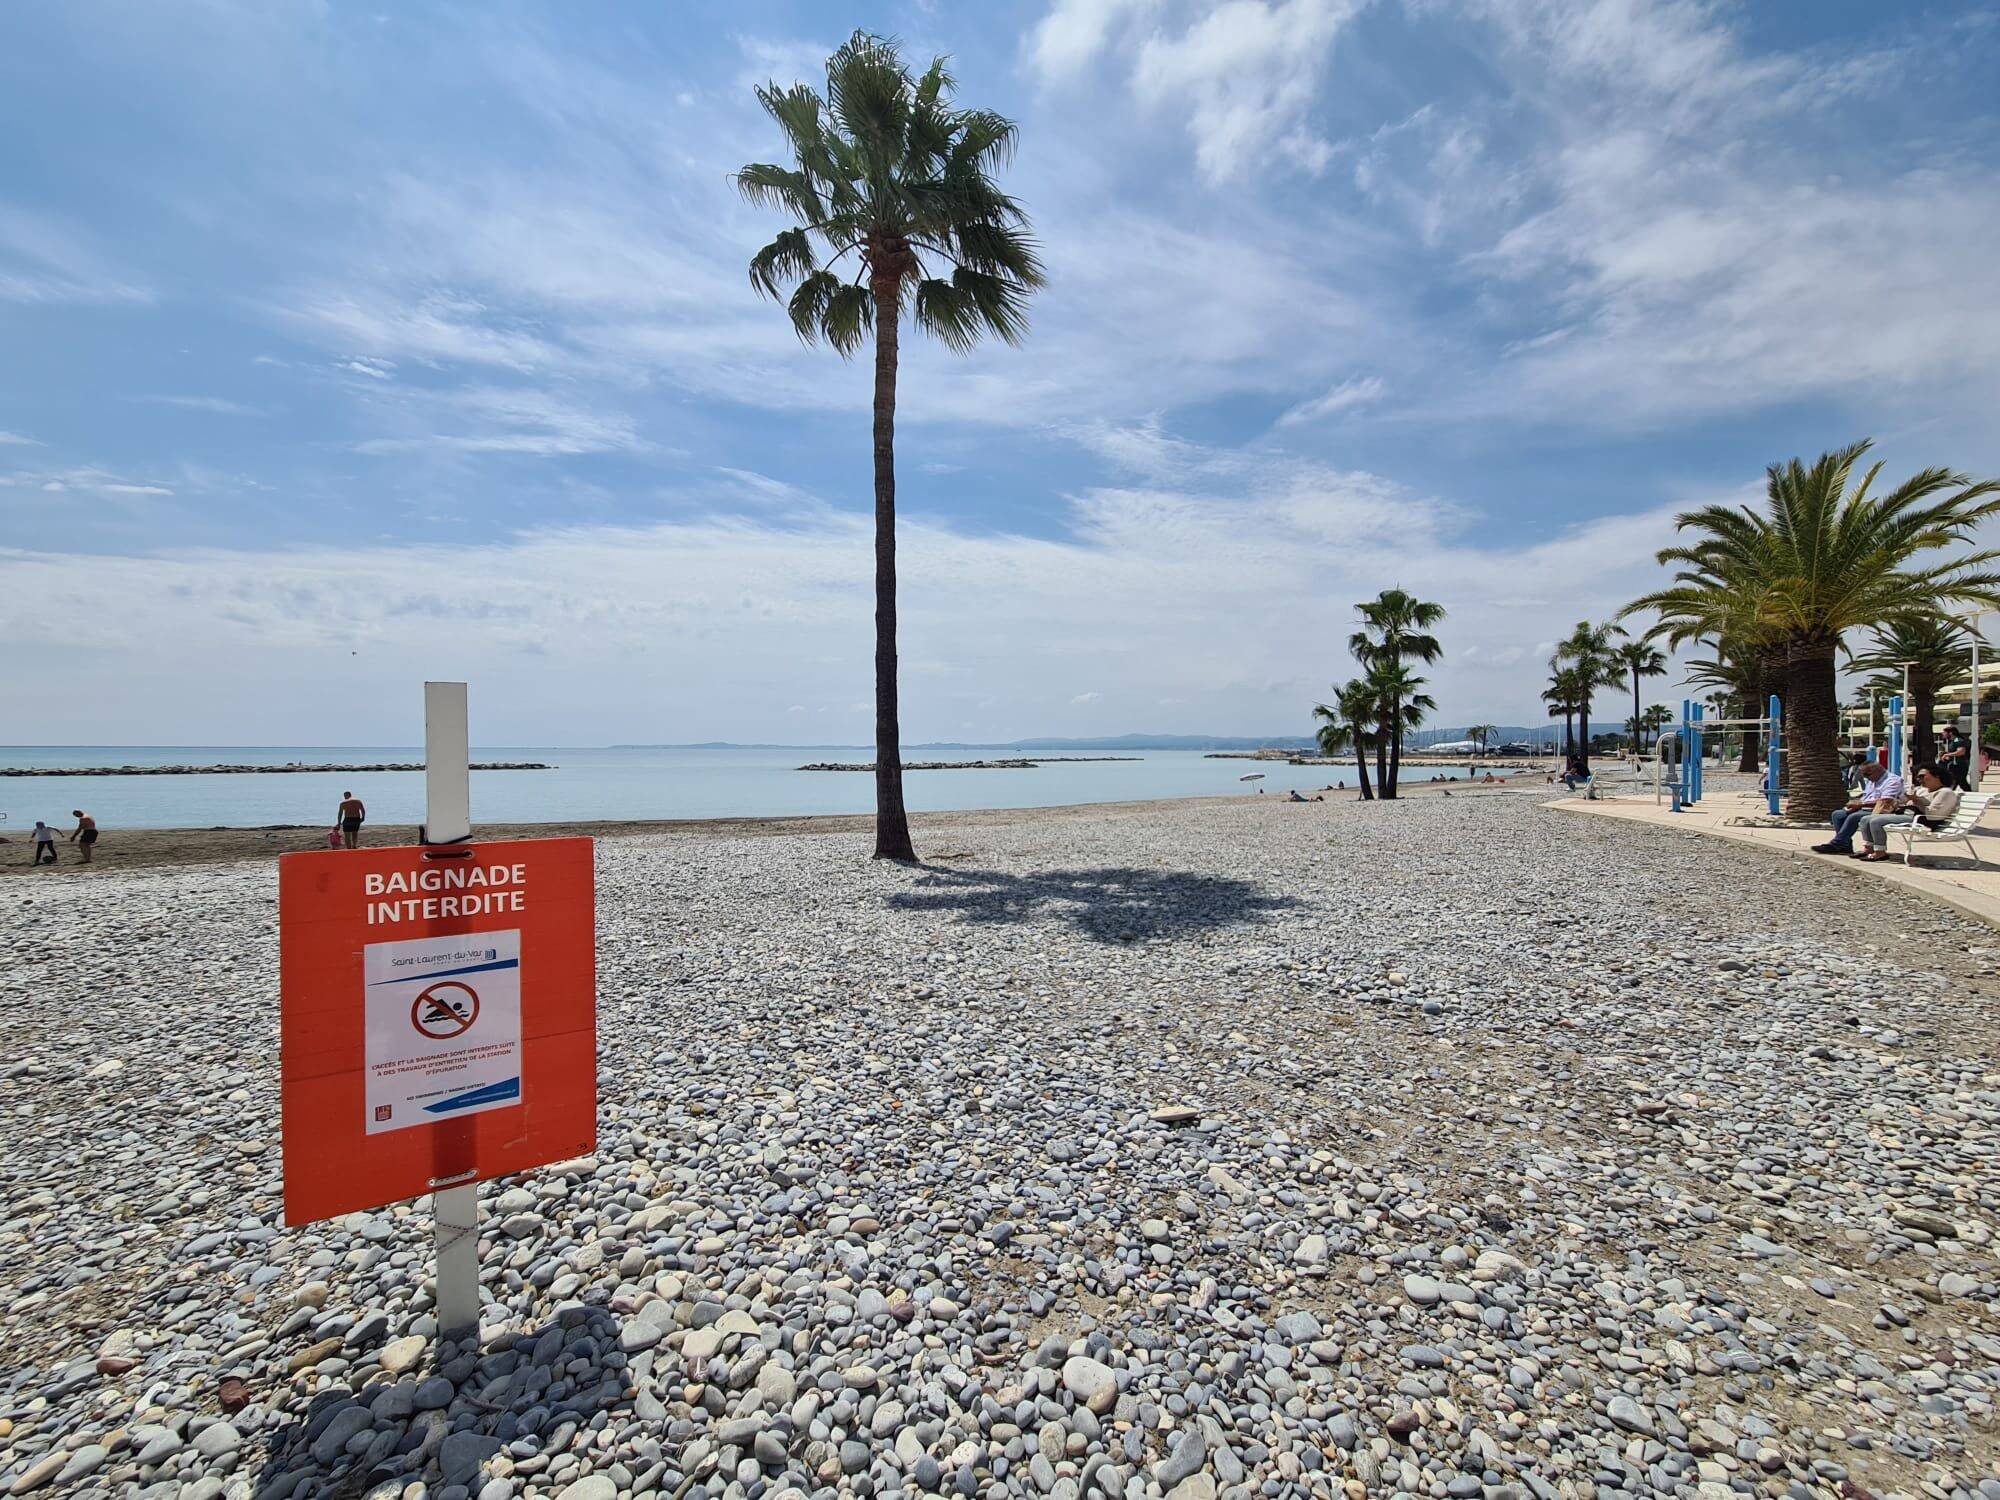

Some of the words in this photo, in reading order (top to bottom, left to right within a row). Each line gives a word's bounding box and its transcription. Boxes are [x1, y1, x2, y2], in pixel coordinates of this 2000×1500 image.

[365, 864, 526, 896] BAIGNADE
[367, 890, 526, 925] INTERDITE
[391, 950, 483, 967] Saint-Laurent-du-Var
[397, 1063, 427, 1074] TRAVAUX
[428, 1057, 468, 1069] D'ENTRETIEN
[487, 1049, 512, 1058] STATION
[415, 1052, 449, 1062] BAIGNADE
[449, 1049, 467, 1058] SONT
[467, 1044, 499, 1054] INTERDITS
[499, 1041, 516, 1049] SUITE
